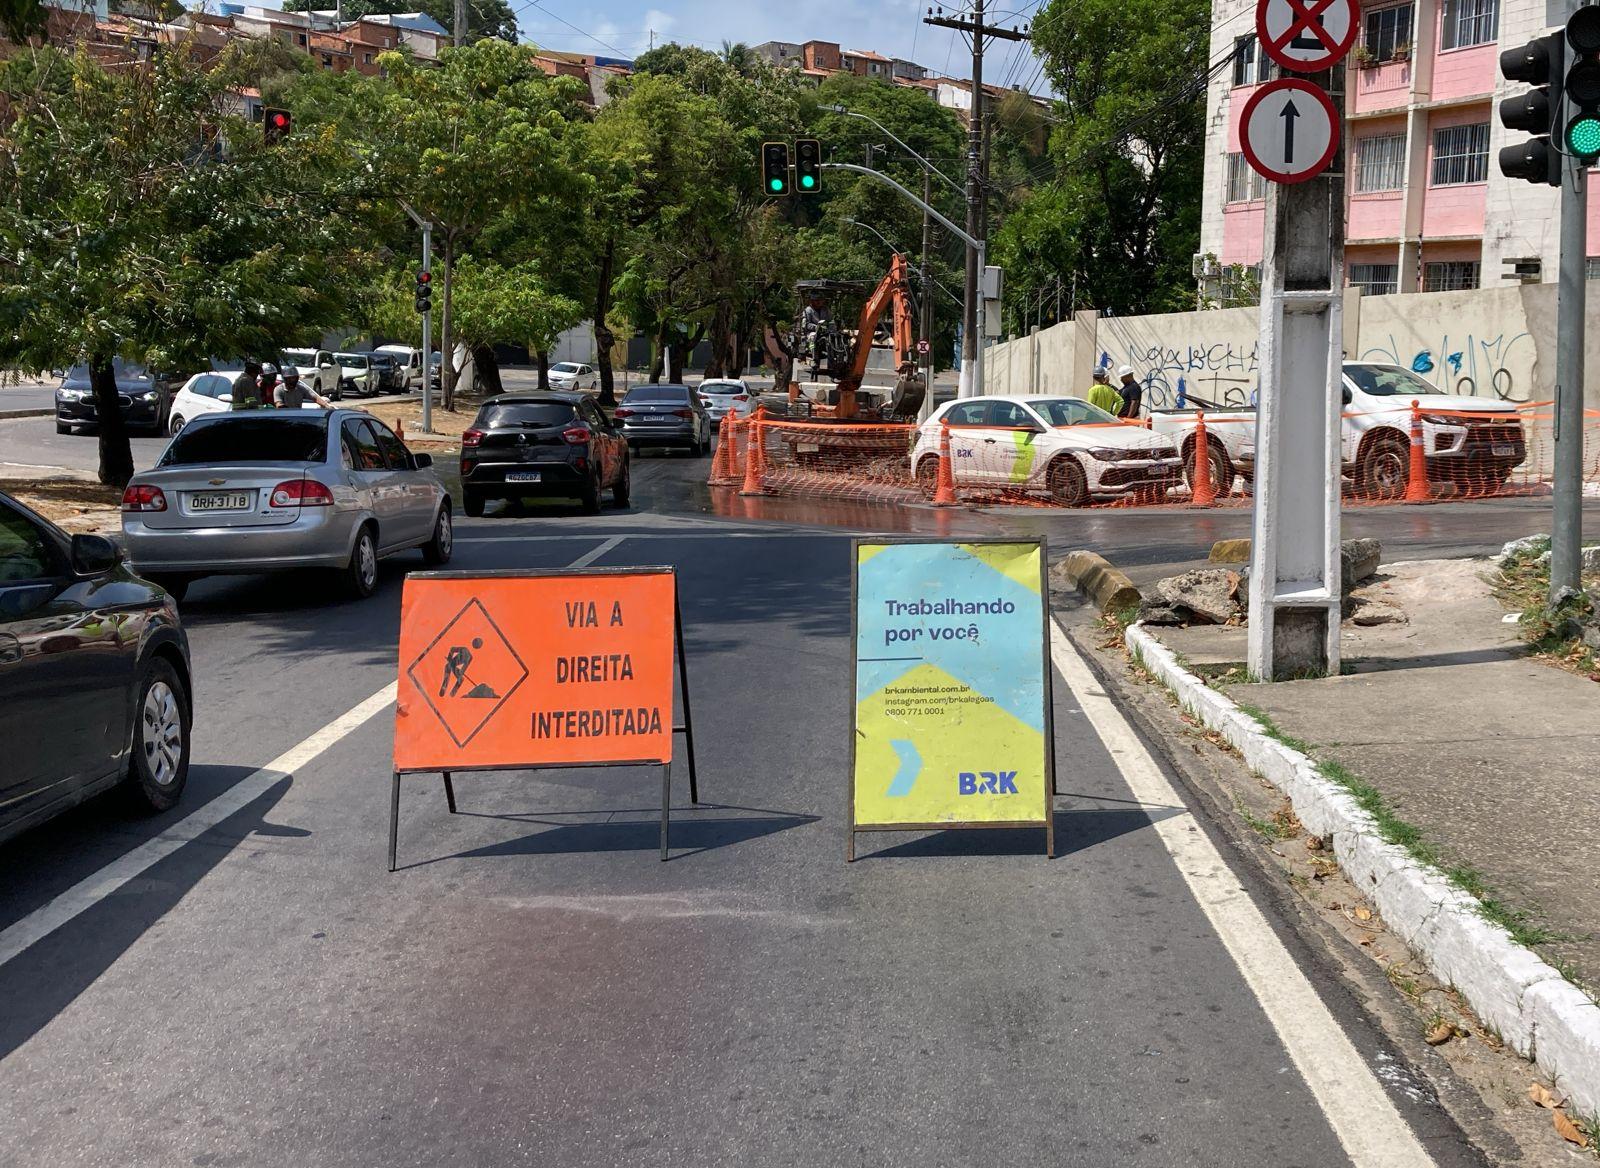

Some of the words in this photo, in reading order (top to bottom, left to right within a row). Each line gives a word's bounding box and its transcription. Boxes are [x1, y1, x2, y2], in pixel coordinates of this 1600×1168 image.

[565, 601, 598, 628] VIA
[610, 601, 623, 627] A
[885, 598, 1015, 616] Trabalhando
[885, 628, 923, 646] por
[929, 623, 979, 641] você
[556, 654, 634, 684] DIREITA
[885, 686, 970, 695] brkambiental.com.br
[531, 707, 662, 739] INTERDITADA
[885, 708, 906, 716] 0800
[908, 708, 922, 716] 771
[924, 707, 944, 715] 0001
[959, 771, 1019, 795] BRK
